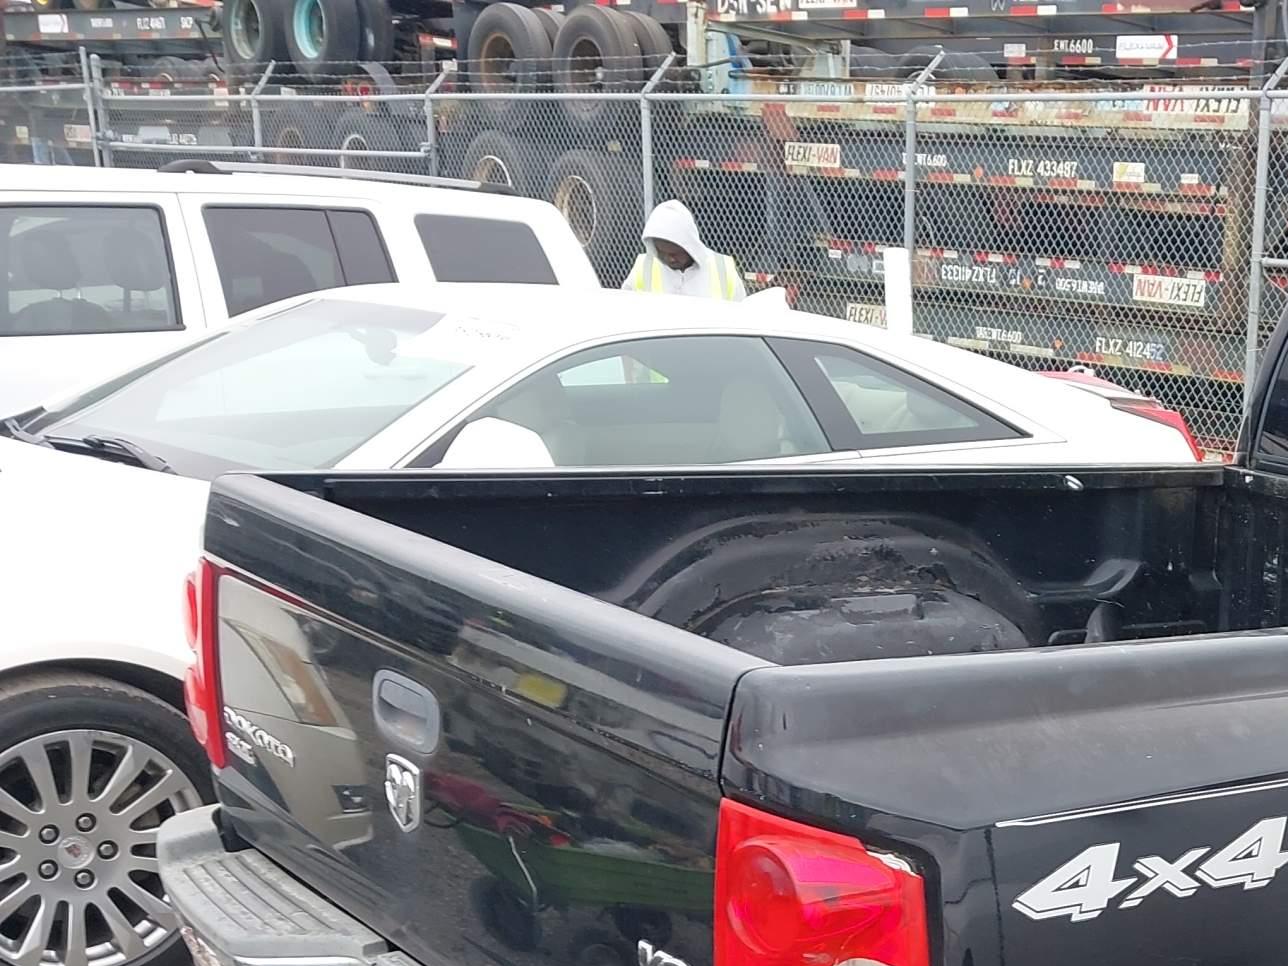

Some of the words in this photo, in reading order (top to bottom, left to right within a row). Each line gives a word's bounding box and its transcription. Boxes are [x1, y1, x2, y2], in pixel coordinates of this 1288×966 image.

[786, 144, 838, 164] FLEXI-VAN
[1008, 158, 1034, 176] FLXZ
[1095, 337, 1122, 355] FLXZ
